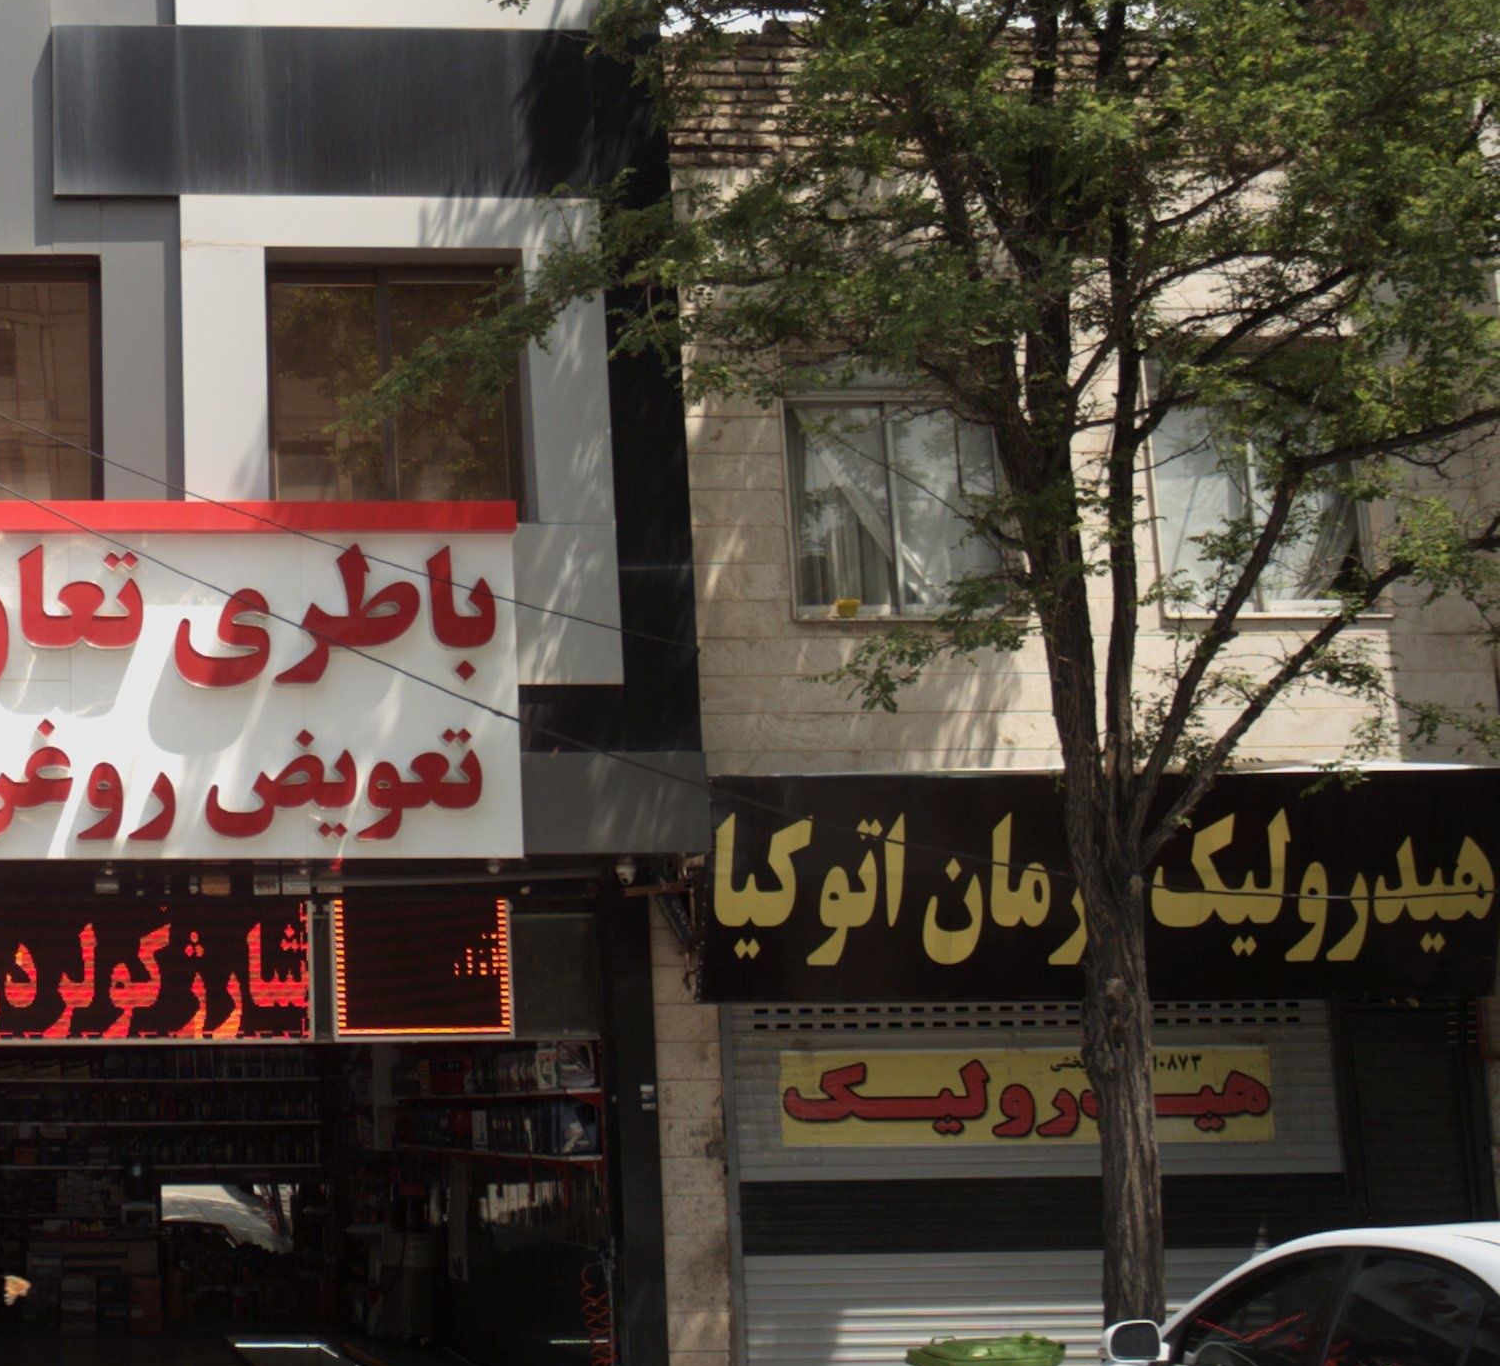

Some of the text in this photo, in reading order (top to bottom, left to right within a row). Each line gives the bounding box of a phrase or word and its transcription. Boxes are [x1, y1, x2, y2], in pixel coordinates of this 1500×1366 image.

[173, 543, 497, 688] باطری
[204, 727, 483, 841] تعویض
[921, 812, 1091, 966] رمان
[1151, 807, 1495, 962] هیدرولیک
[41, 921, 172, 1039] کولر
[174, 923, 309, 1039] شارژ
